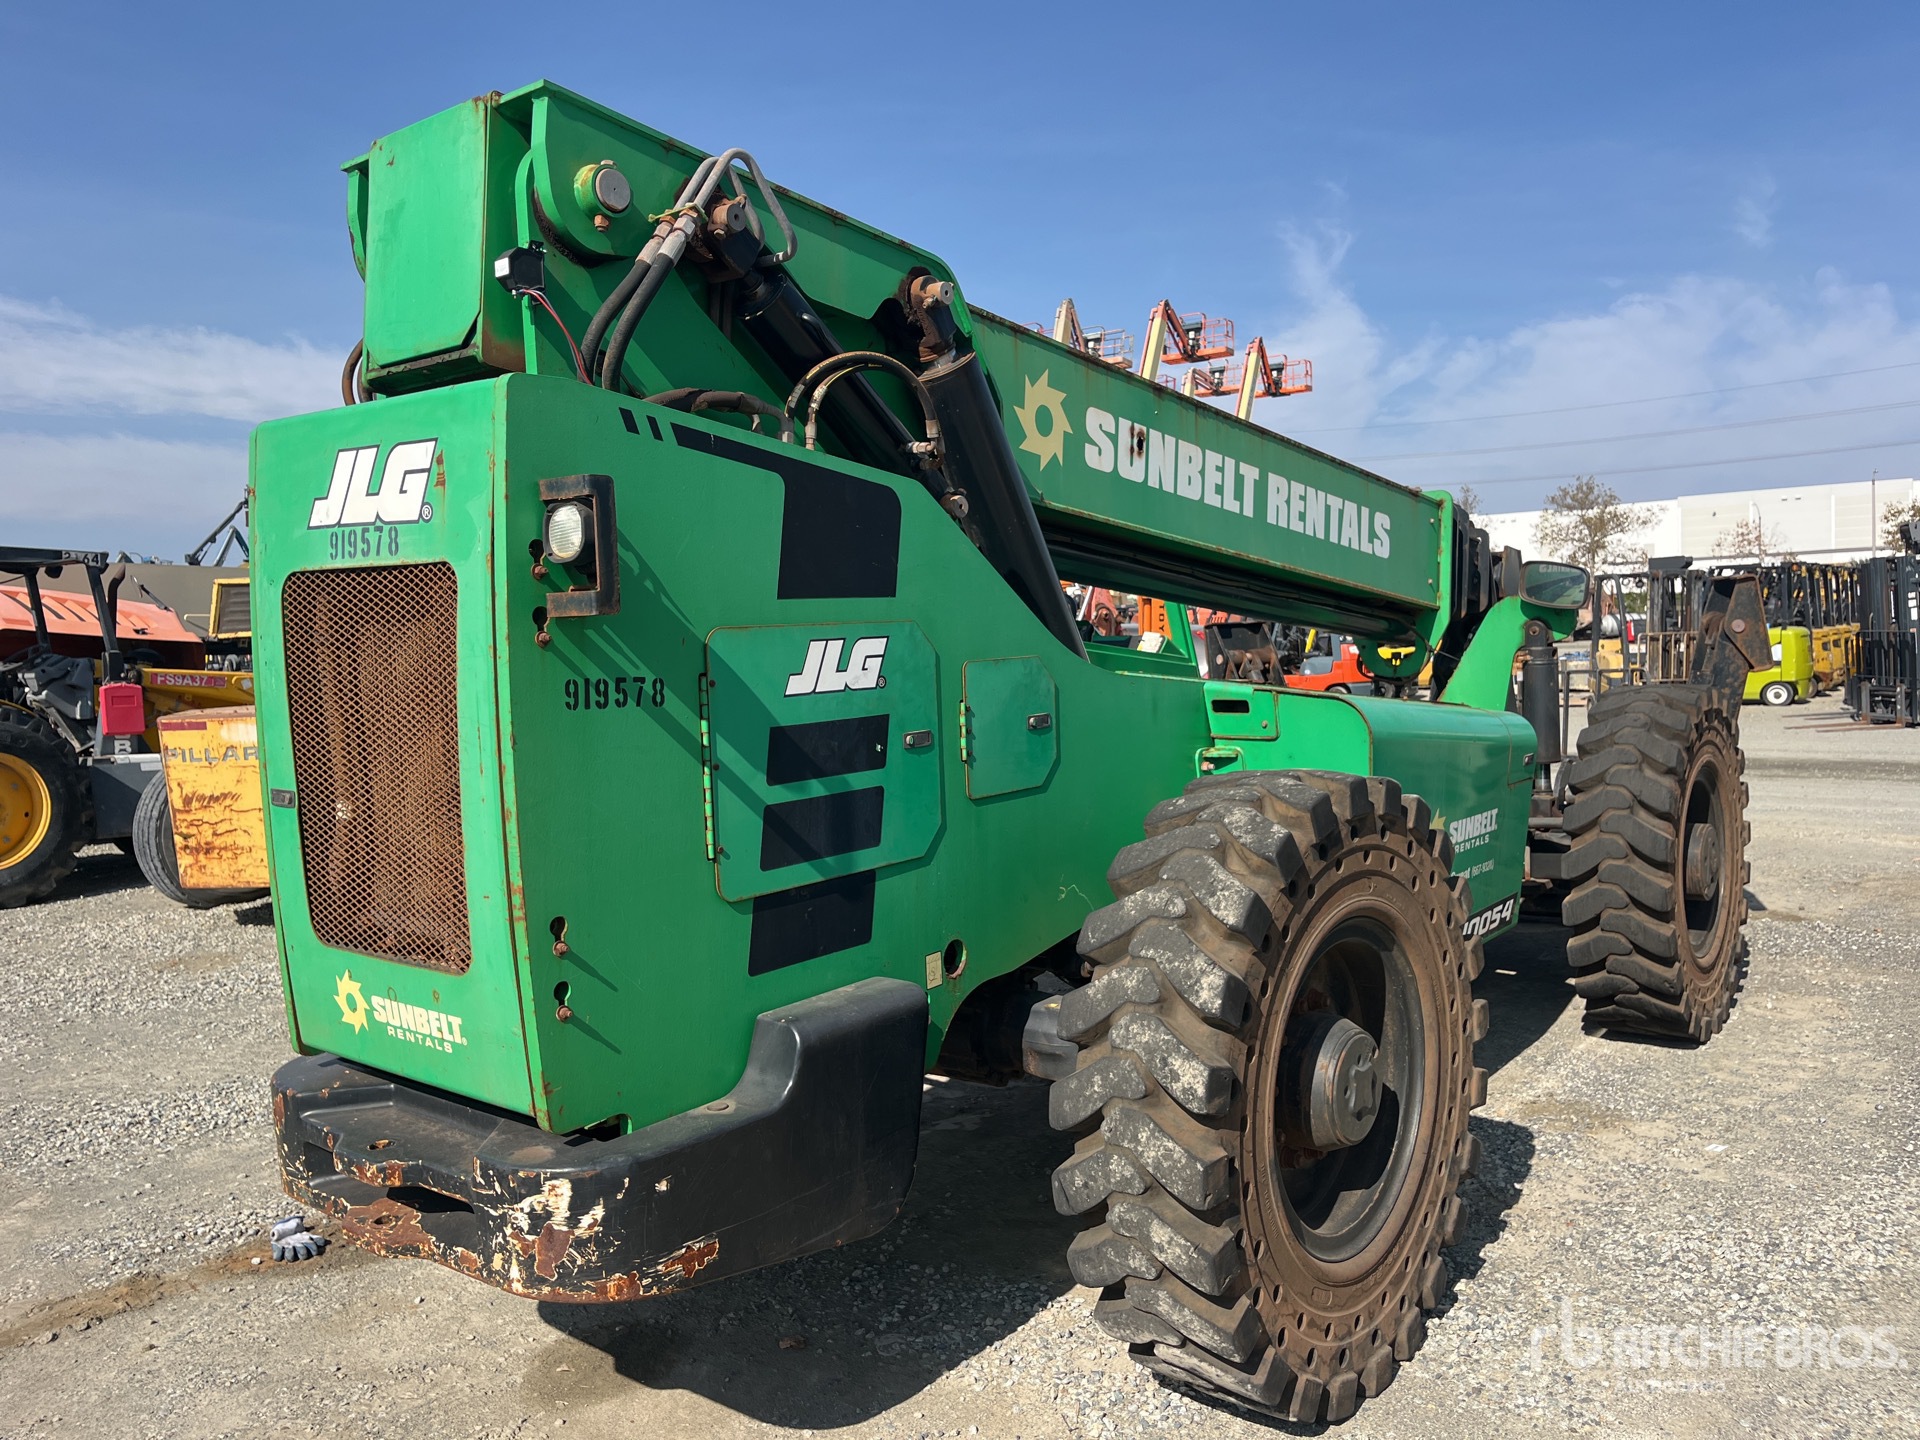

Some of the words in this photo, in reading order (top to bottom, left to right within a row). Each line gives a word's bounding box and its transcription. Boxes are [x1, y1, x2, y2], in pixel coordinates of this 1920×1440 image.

[1084, 406, 1260, 518] SUNBELT
[1266, 472, 1391, 559] RENTALS
[330, 526, 399, 560] 919578
[157, 673, 208, 687] FS9A37
[564, 676, 666, 711] 919578
[1450, 808, 1499, 844] SUNBELT
[1454, 834, 1490, 854] RENTALS
[371, 995, 463, 1043] SUNBELT
[387, 1026, 453, 1053] RENTALS
